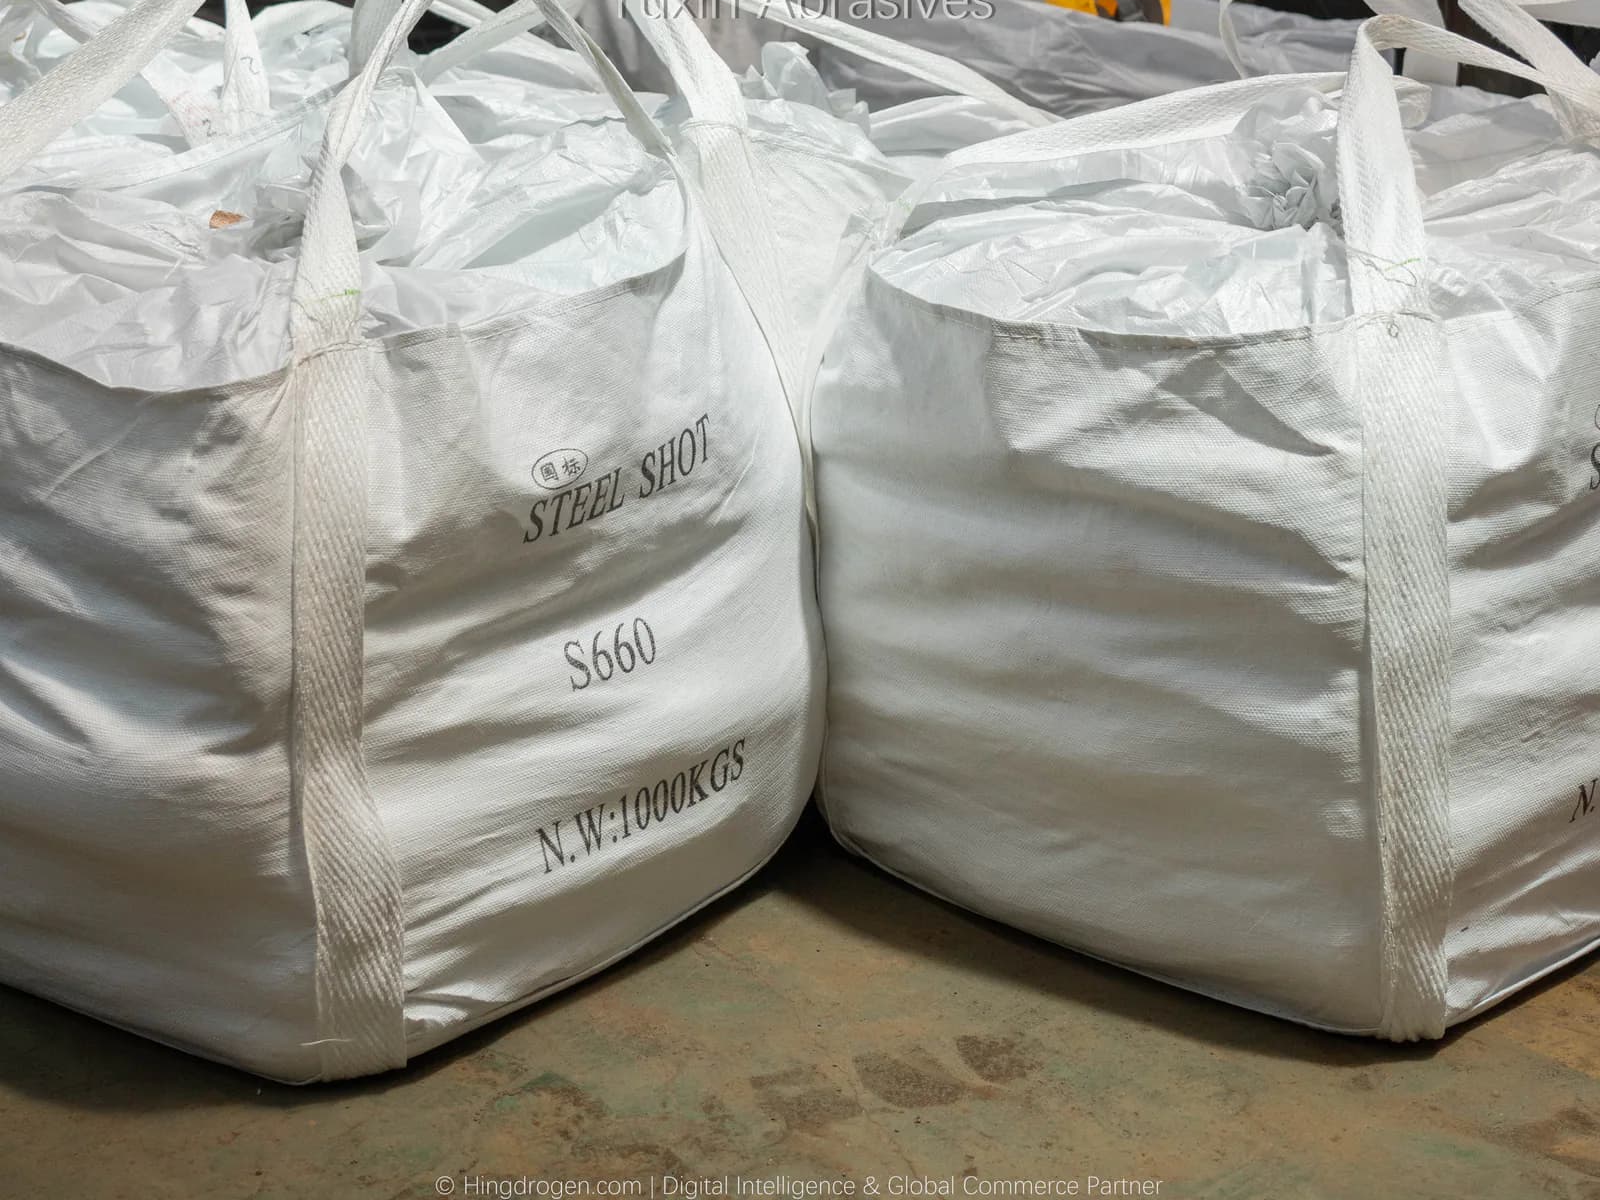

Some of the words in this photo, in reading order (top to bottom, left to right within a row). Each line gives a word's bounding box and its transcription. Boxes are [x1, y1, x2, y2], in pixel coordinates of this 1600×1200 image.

[523, 467, 625, 544] STEEL
[639, 412, 710, 499] SHOT
[564, 617, 656, 692] S660
